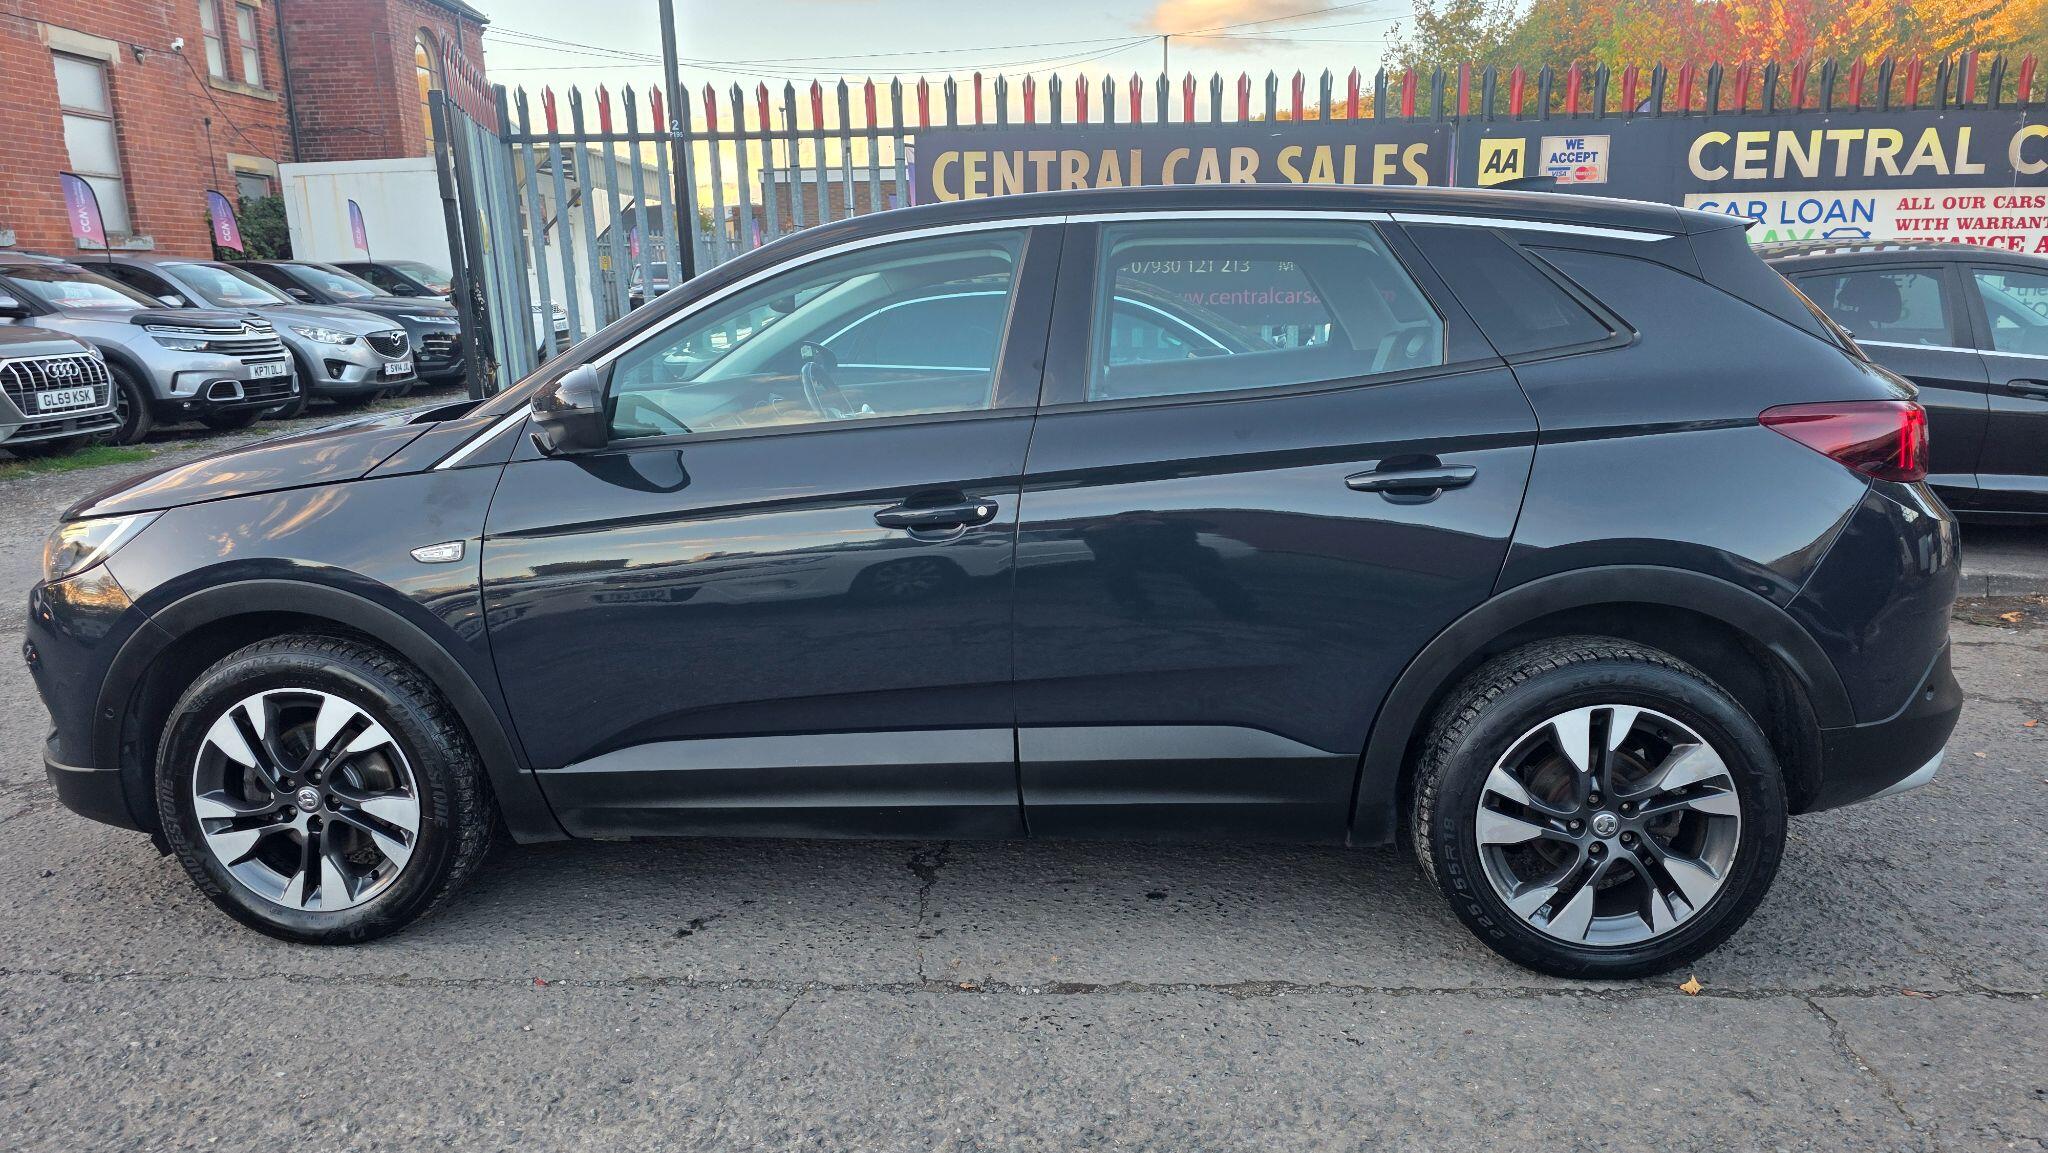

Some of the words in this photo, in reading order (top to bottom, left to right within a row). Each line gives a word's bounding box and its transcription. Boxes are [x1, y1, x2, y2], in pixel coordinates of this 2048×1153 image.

[672, 119, 679, 131] 2
[1565, 138, 1585, 150] WE
[1483, 148, 1519, 174] AA
[1550, 151, 1599, 164] ACCEPT
[1688, 126, 1986, 182] CENTRAL
[932, 149, 1142, 202] CENTRAL
[1161, 147, 1260, 186] CAR
[1276, 142, 1430, 187] SALES
[1780, 198, 1876, 225] LOAN
[1896, 197, 1935, 211] ALL
[1942, 196, 1986, 210] OUR
[1993, 195, 2046, 209] CARS
[1895, 217, 1950, 231] WITH
[43, 392, 71, 407] GL69
[73, 389, 91, 403] KSK
